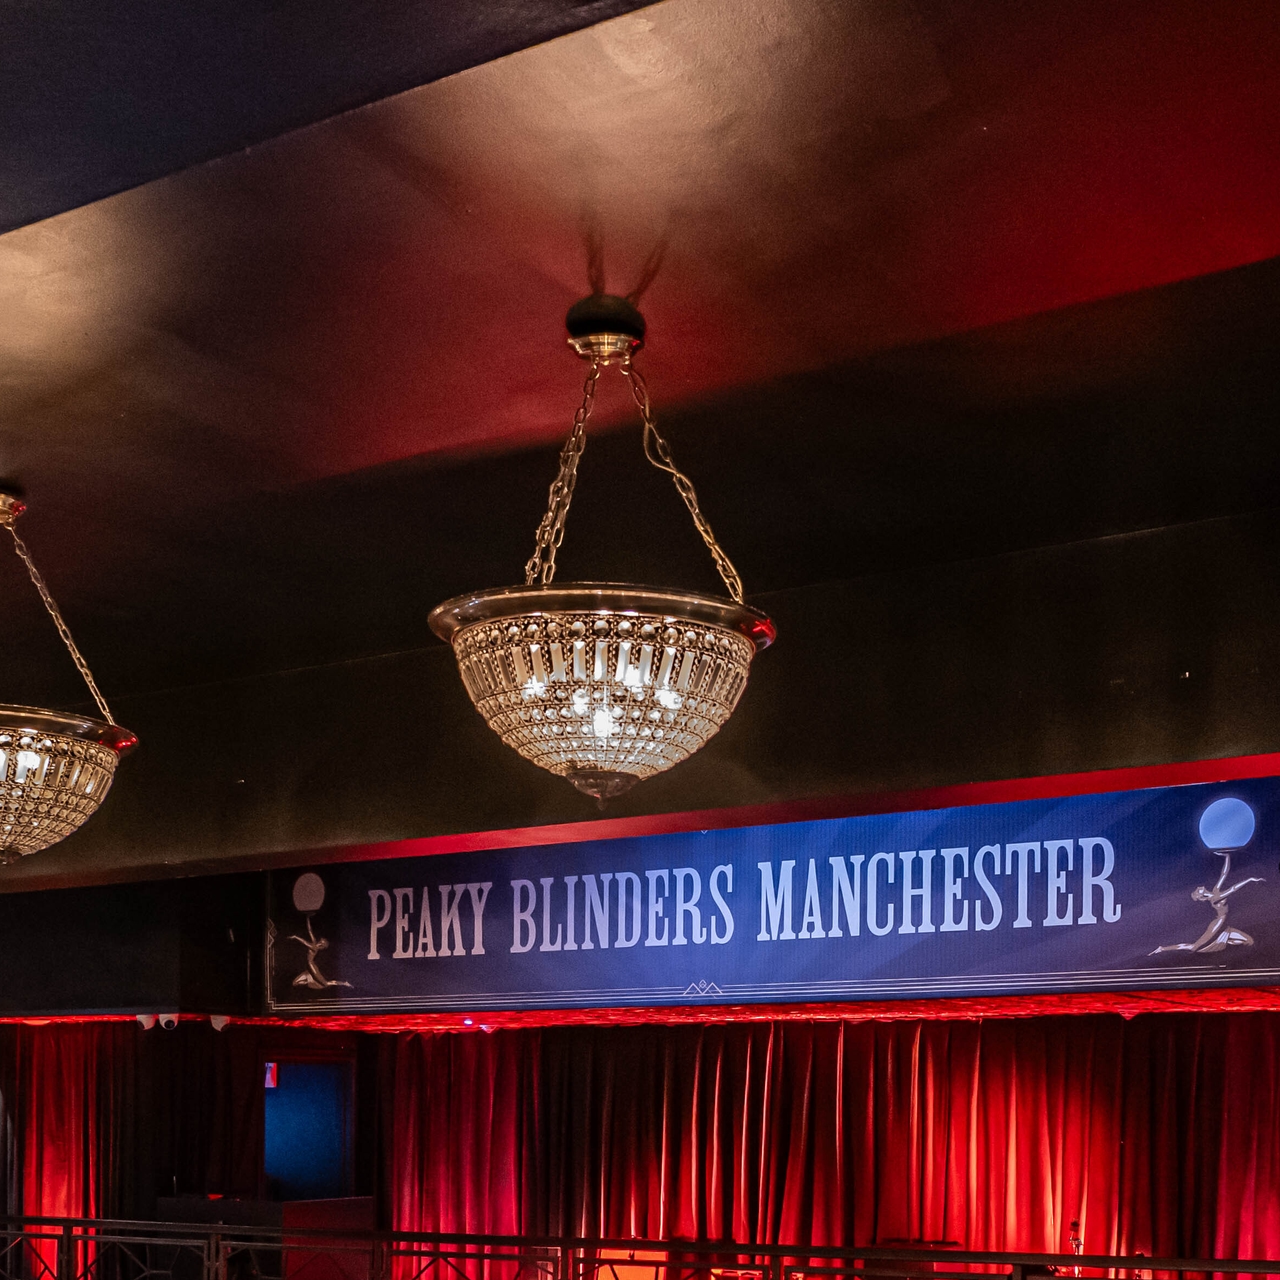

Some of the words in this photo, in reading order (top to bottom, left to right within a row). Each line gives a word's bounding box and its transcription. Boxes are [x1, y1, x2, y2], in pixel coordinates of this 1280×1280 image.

[367, 881, 493, 960] PEAKY
[510, 863, 735, 954] BLINDERS
[756, 836, 1122, 942] MANCHESTER
